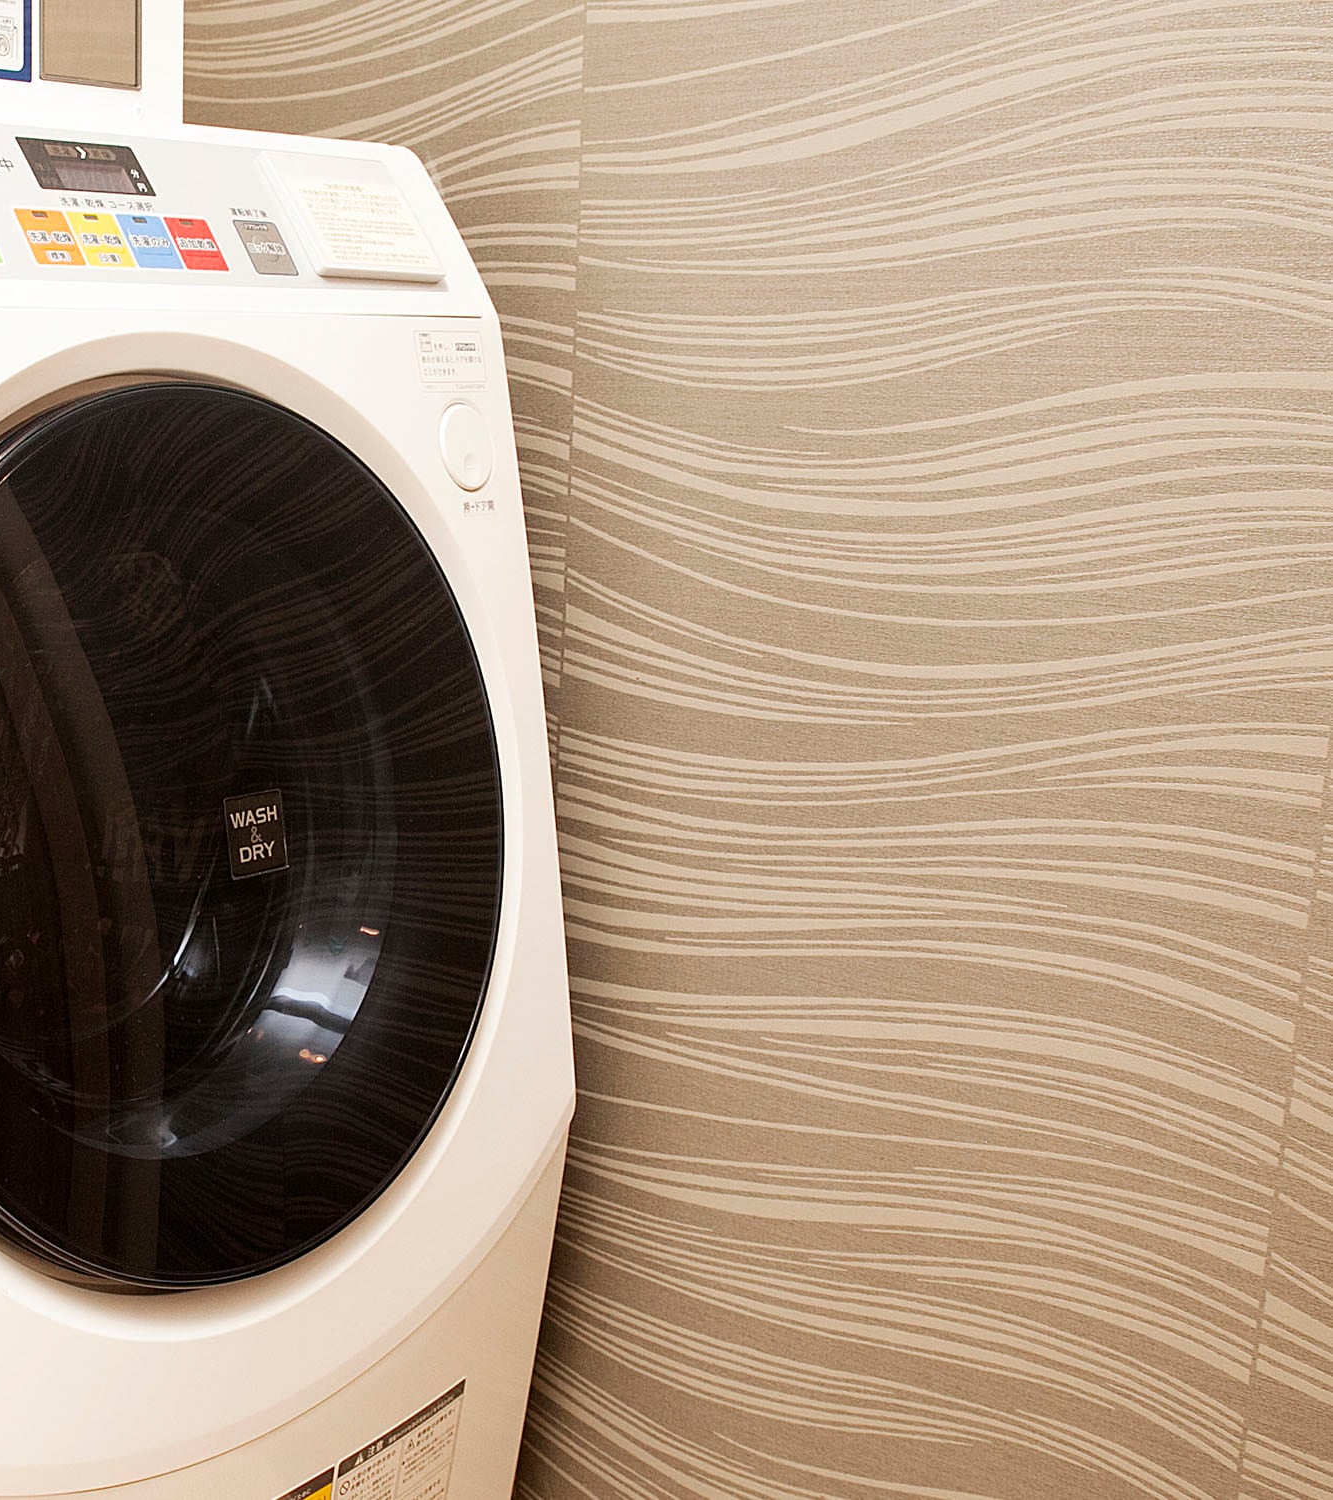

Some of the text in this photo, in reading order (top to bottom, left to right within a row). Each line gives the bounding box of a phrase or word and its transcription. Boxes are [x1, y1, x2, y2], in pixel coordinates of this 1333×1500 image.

[130, 168, 141, 180] 分
[230, 805, 278, 828] WASH
[250, 826, 263, 844] &
[239, 841, 276, 863] DRY
